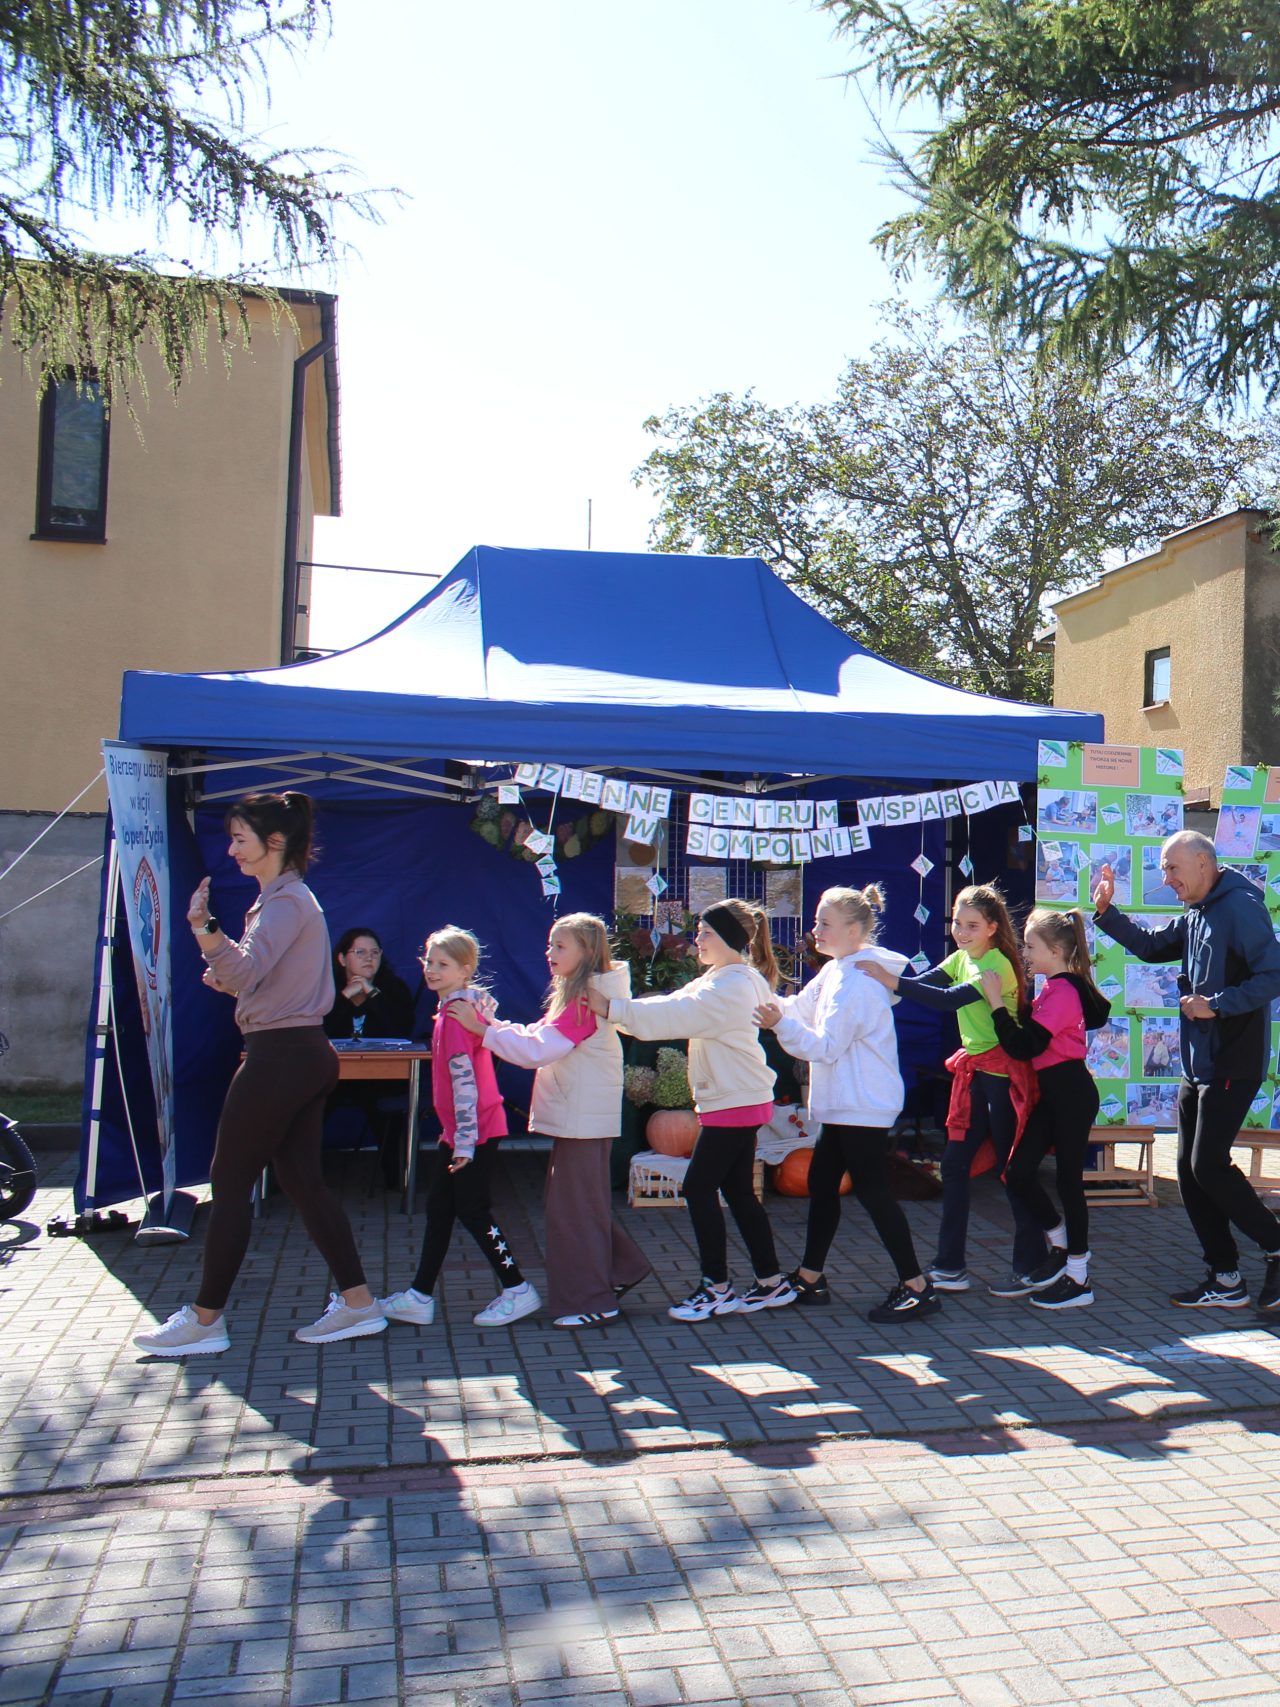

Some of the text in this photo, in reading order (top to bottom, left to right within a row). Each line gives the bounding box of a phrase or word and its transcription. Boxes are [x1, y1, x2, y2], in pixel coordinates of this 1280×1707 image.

[109, 754, 165, 782] Bierzemy udział
[516, 763, 1017, 825] DZIENNE CENTRUM WSPARCIA
[144, 819, 164, 850] Życia
[631, 815, 866, 857] W SOMPOLNIE
